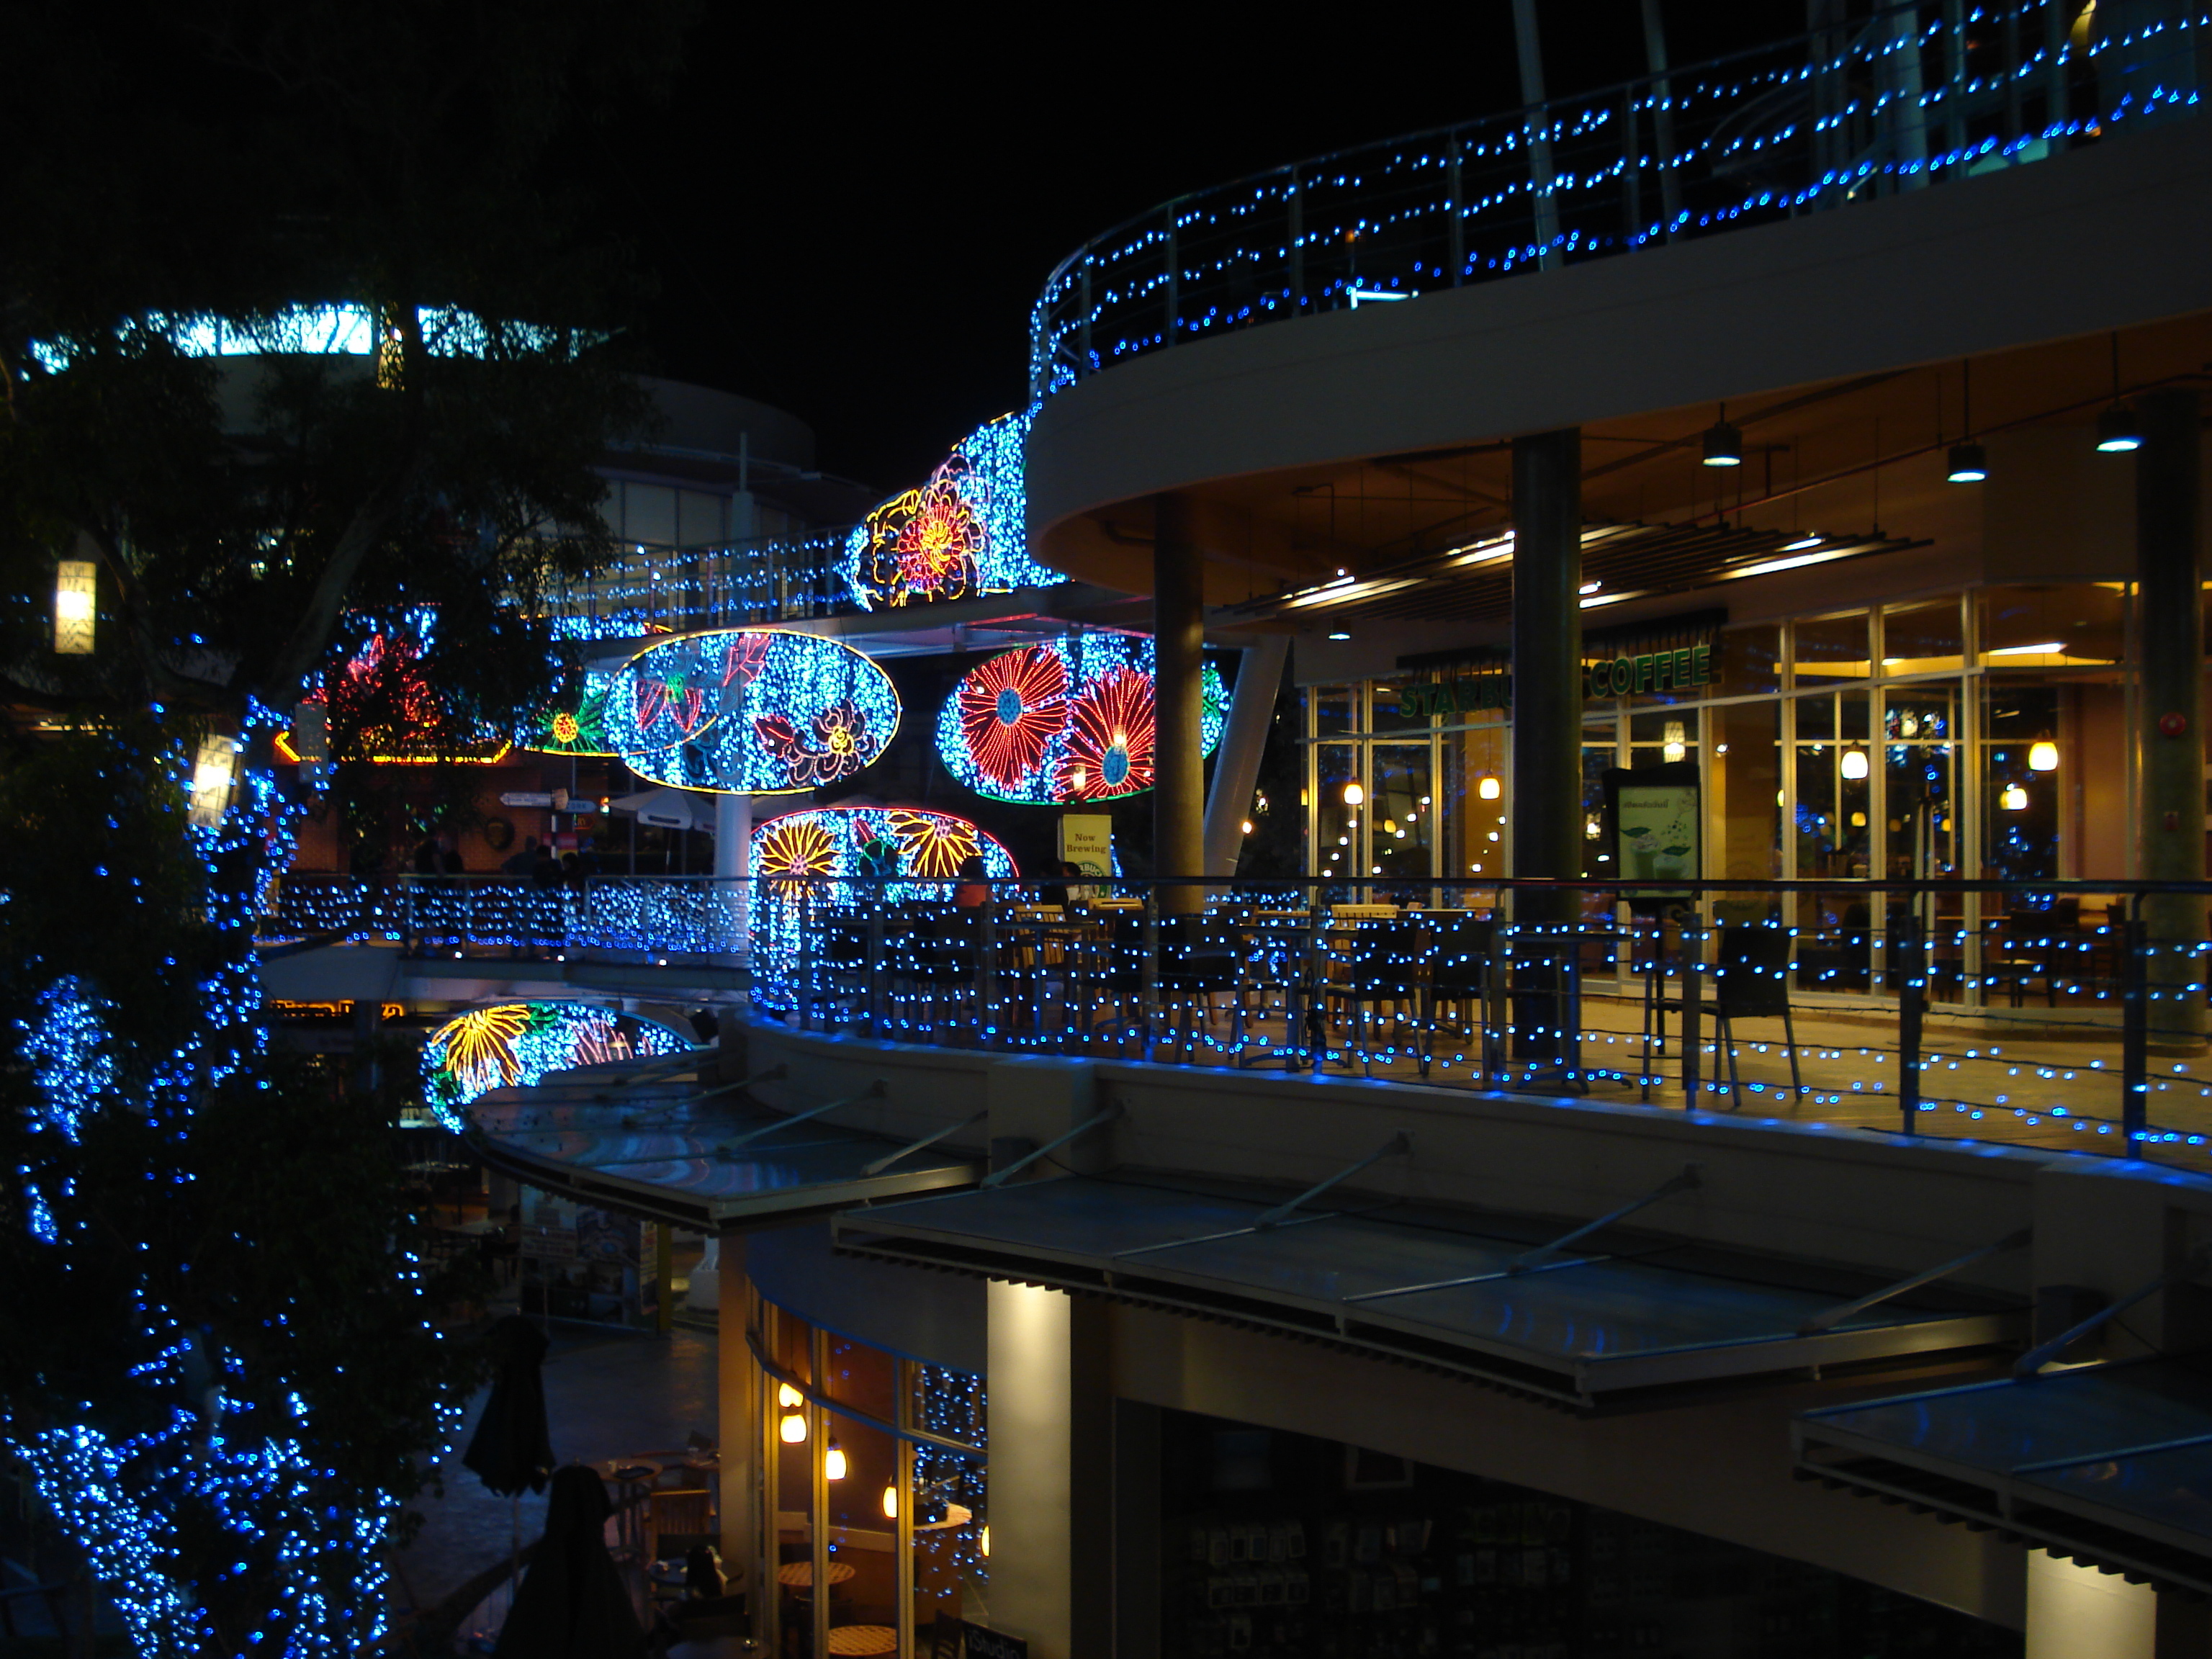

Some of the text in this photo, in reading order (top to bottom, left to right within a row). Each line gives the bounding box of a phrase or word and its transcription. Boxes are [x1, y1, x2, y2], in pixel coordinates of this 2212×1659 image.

[1400, 644, 1711, 717] STARBU COFFEE
[1066, 845, 1106, 854] Brewing
